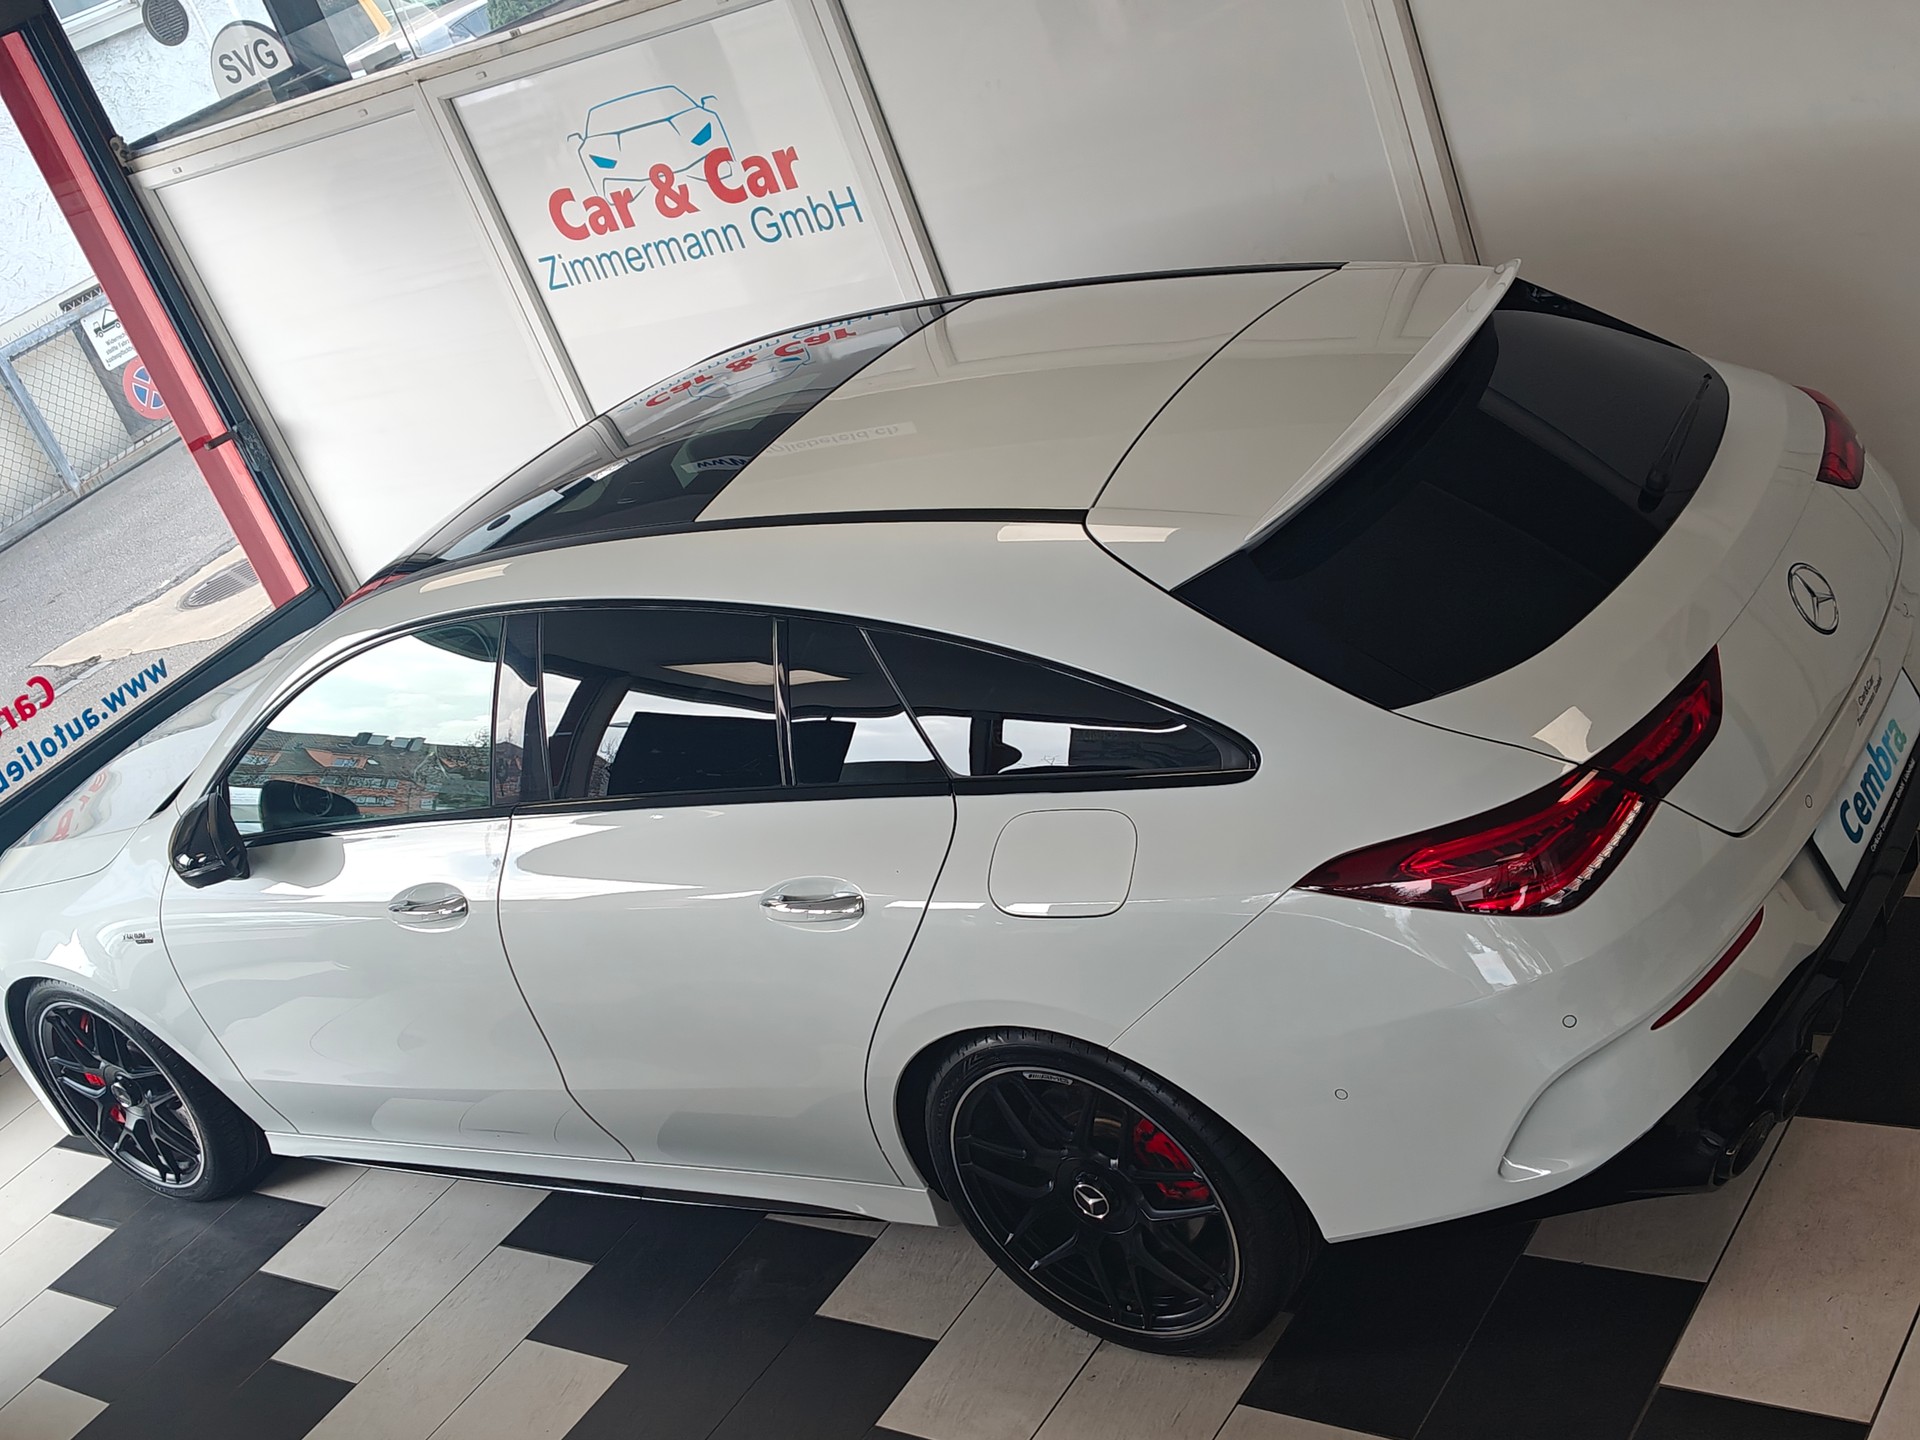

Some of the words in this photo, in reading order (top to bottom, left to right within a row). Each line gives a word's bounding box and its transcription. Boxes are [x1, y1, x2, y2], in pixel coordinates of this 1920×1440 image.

[218, 37, 279, 84] SVG
[538, 223, 746, 291] Zimmermann
[750, 186, 864, 243] GmbH
[549, 187, 637, 240] Car
[648, 163, 701, 218] &
[704, 146, 799, 204] Car
[1840, 718, 1907, 844] Cembra
